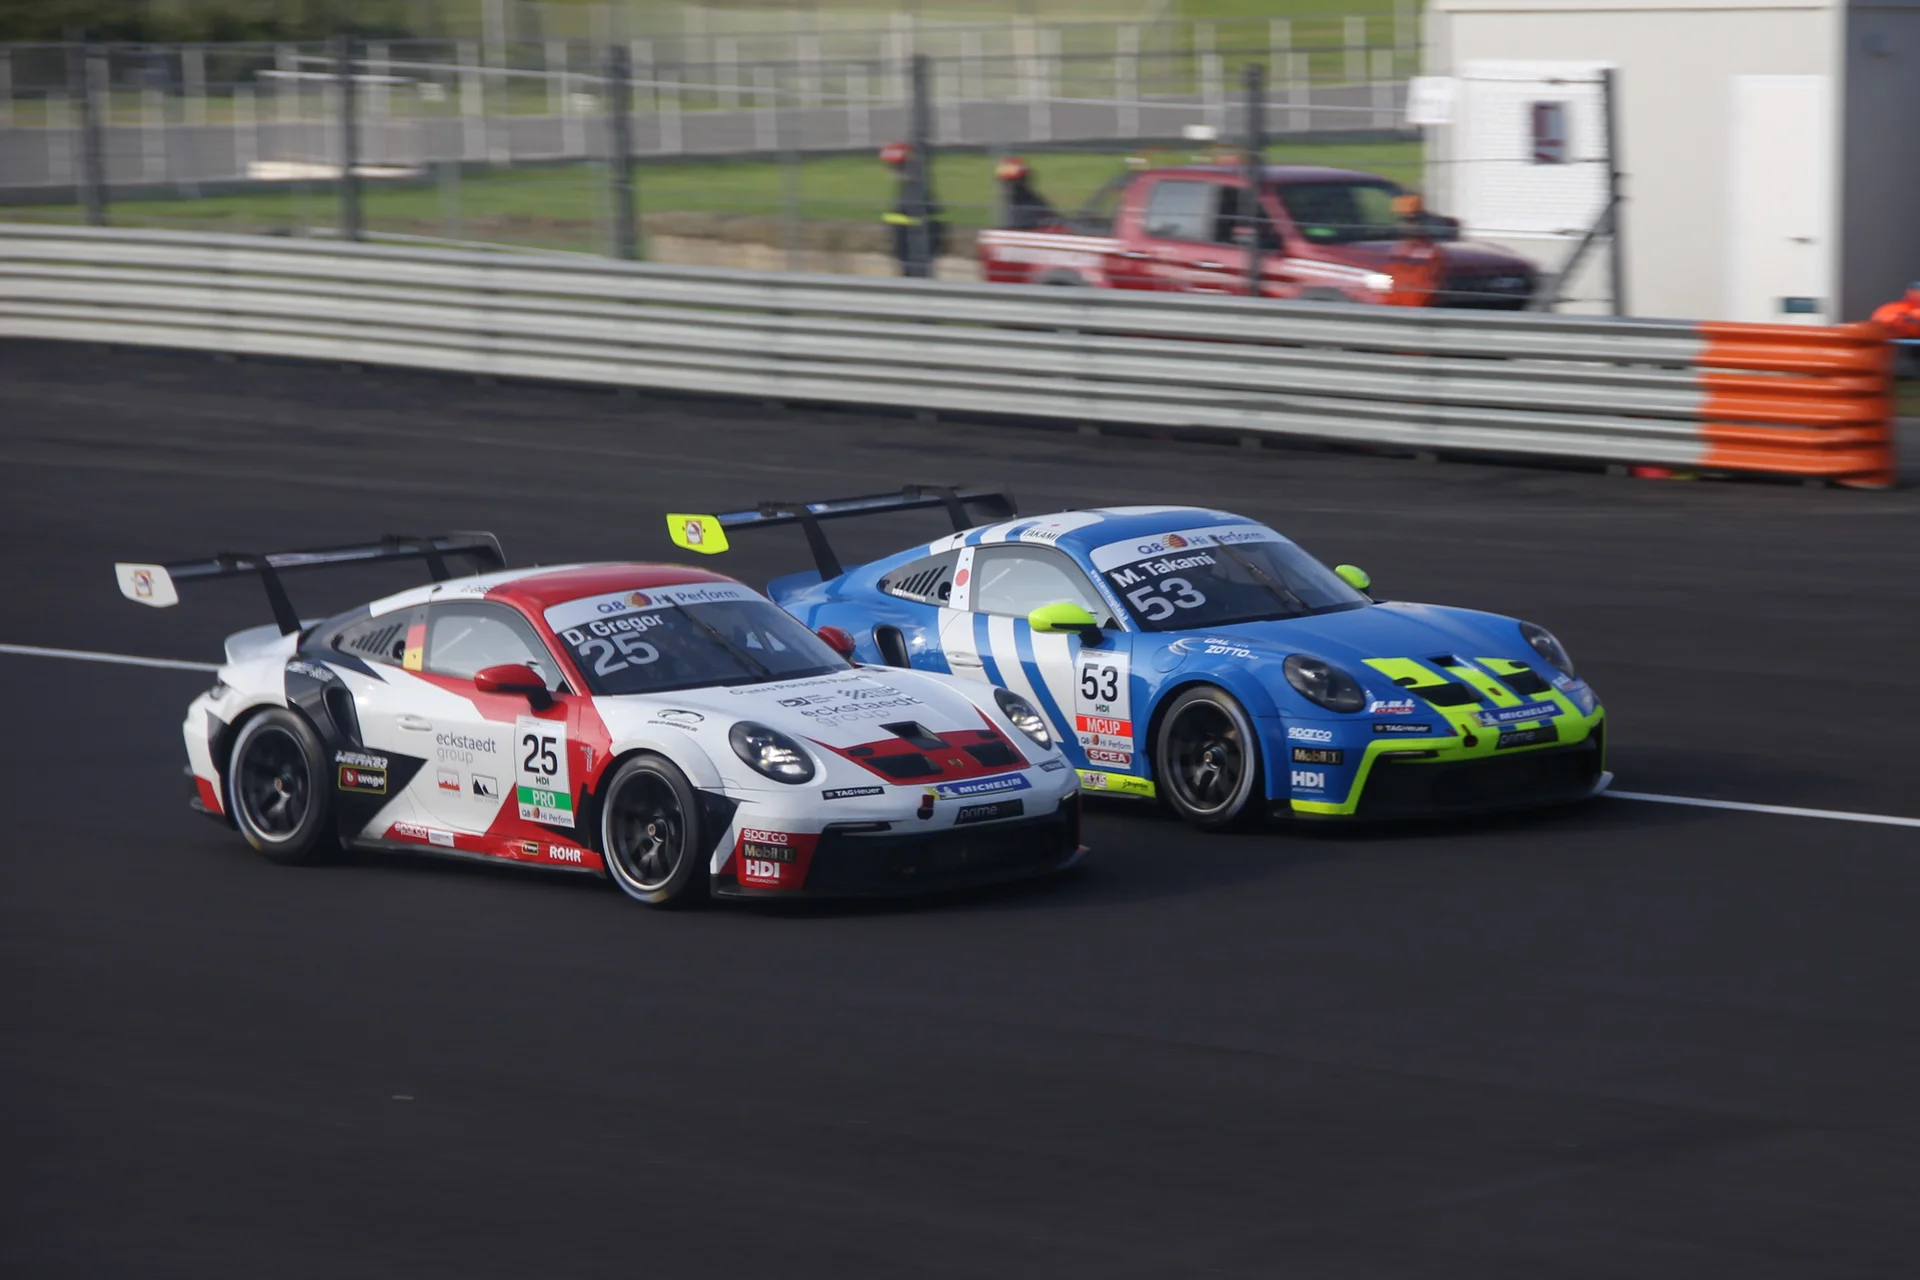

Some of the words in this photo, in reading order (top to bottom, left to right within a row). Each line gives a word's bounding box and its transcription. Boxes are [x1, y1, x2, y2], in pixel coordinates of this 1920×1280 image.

[1023, 529, 1060, 540] TAKAMI
[1137, 543, 1164, 554] Q8
[1188, 535, 1208, 545] Hi
[1110, 569, 1146, 588] M.
[1138, 552, 1217, 577] Takami
[597, 601, 626, 613] Q8
[676, 589, 740, 602] Perform
[1125, 577, 1206, 622] 53
[562, 628, 592, 646] D.
[589, 613, 664, 638] Gregor
[1203, 637, 1229, 646] DAL
[578, 632, 660, 677] 25
[1204, 645, 1251, 658] ZOTTO
[1081, 663, 1119, 702] 53
[800, 697, 924, 718] eckstaedt
[1095, 704, 1110, 713] HDI
[1498, 705, 1556, 720] MICHELIN
[815, 709, 891, 727] group
[1086, 718, 1120, 735] MCUP
[1288, 727, 1332, 741] sparco
[436, 732, 497, 754] eckstaedt
[1080, 737, 1090, 746] Q8
[1100, 738, 1107, 747] Hi
[1108, 739, 1132, 751] Perform
[436, 747, 474, 766] group
[522, 734, 558, 776] 25
[1090, 750, 1127, 763] SCEA
[1294, 748, 1327, 762] Mobil
[535, 776, 550, 786] HDI
[959, 778, 1022, 793] MICHELIN
[1291, 770, 1325, 788] HDI
[532, 789, 556, 807] PRO
[521, 809, 531, 818] Q8
[541, 811, 548, 820] Hi
[549, 813, 573, 826] Perform
[960, 805, 998, 819] prime
[743, 829, 788, 844] sparco
[549, 845, 582, 863] ROHR
[744, 844, 778, 860] Mobil
[746, 859, 780, 878] HDI
